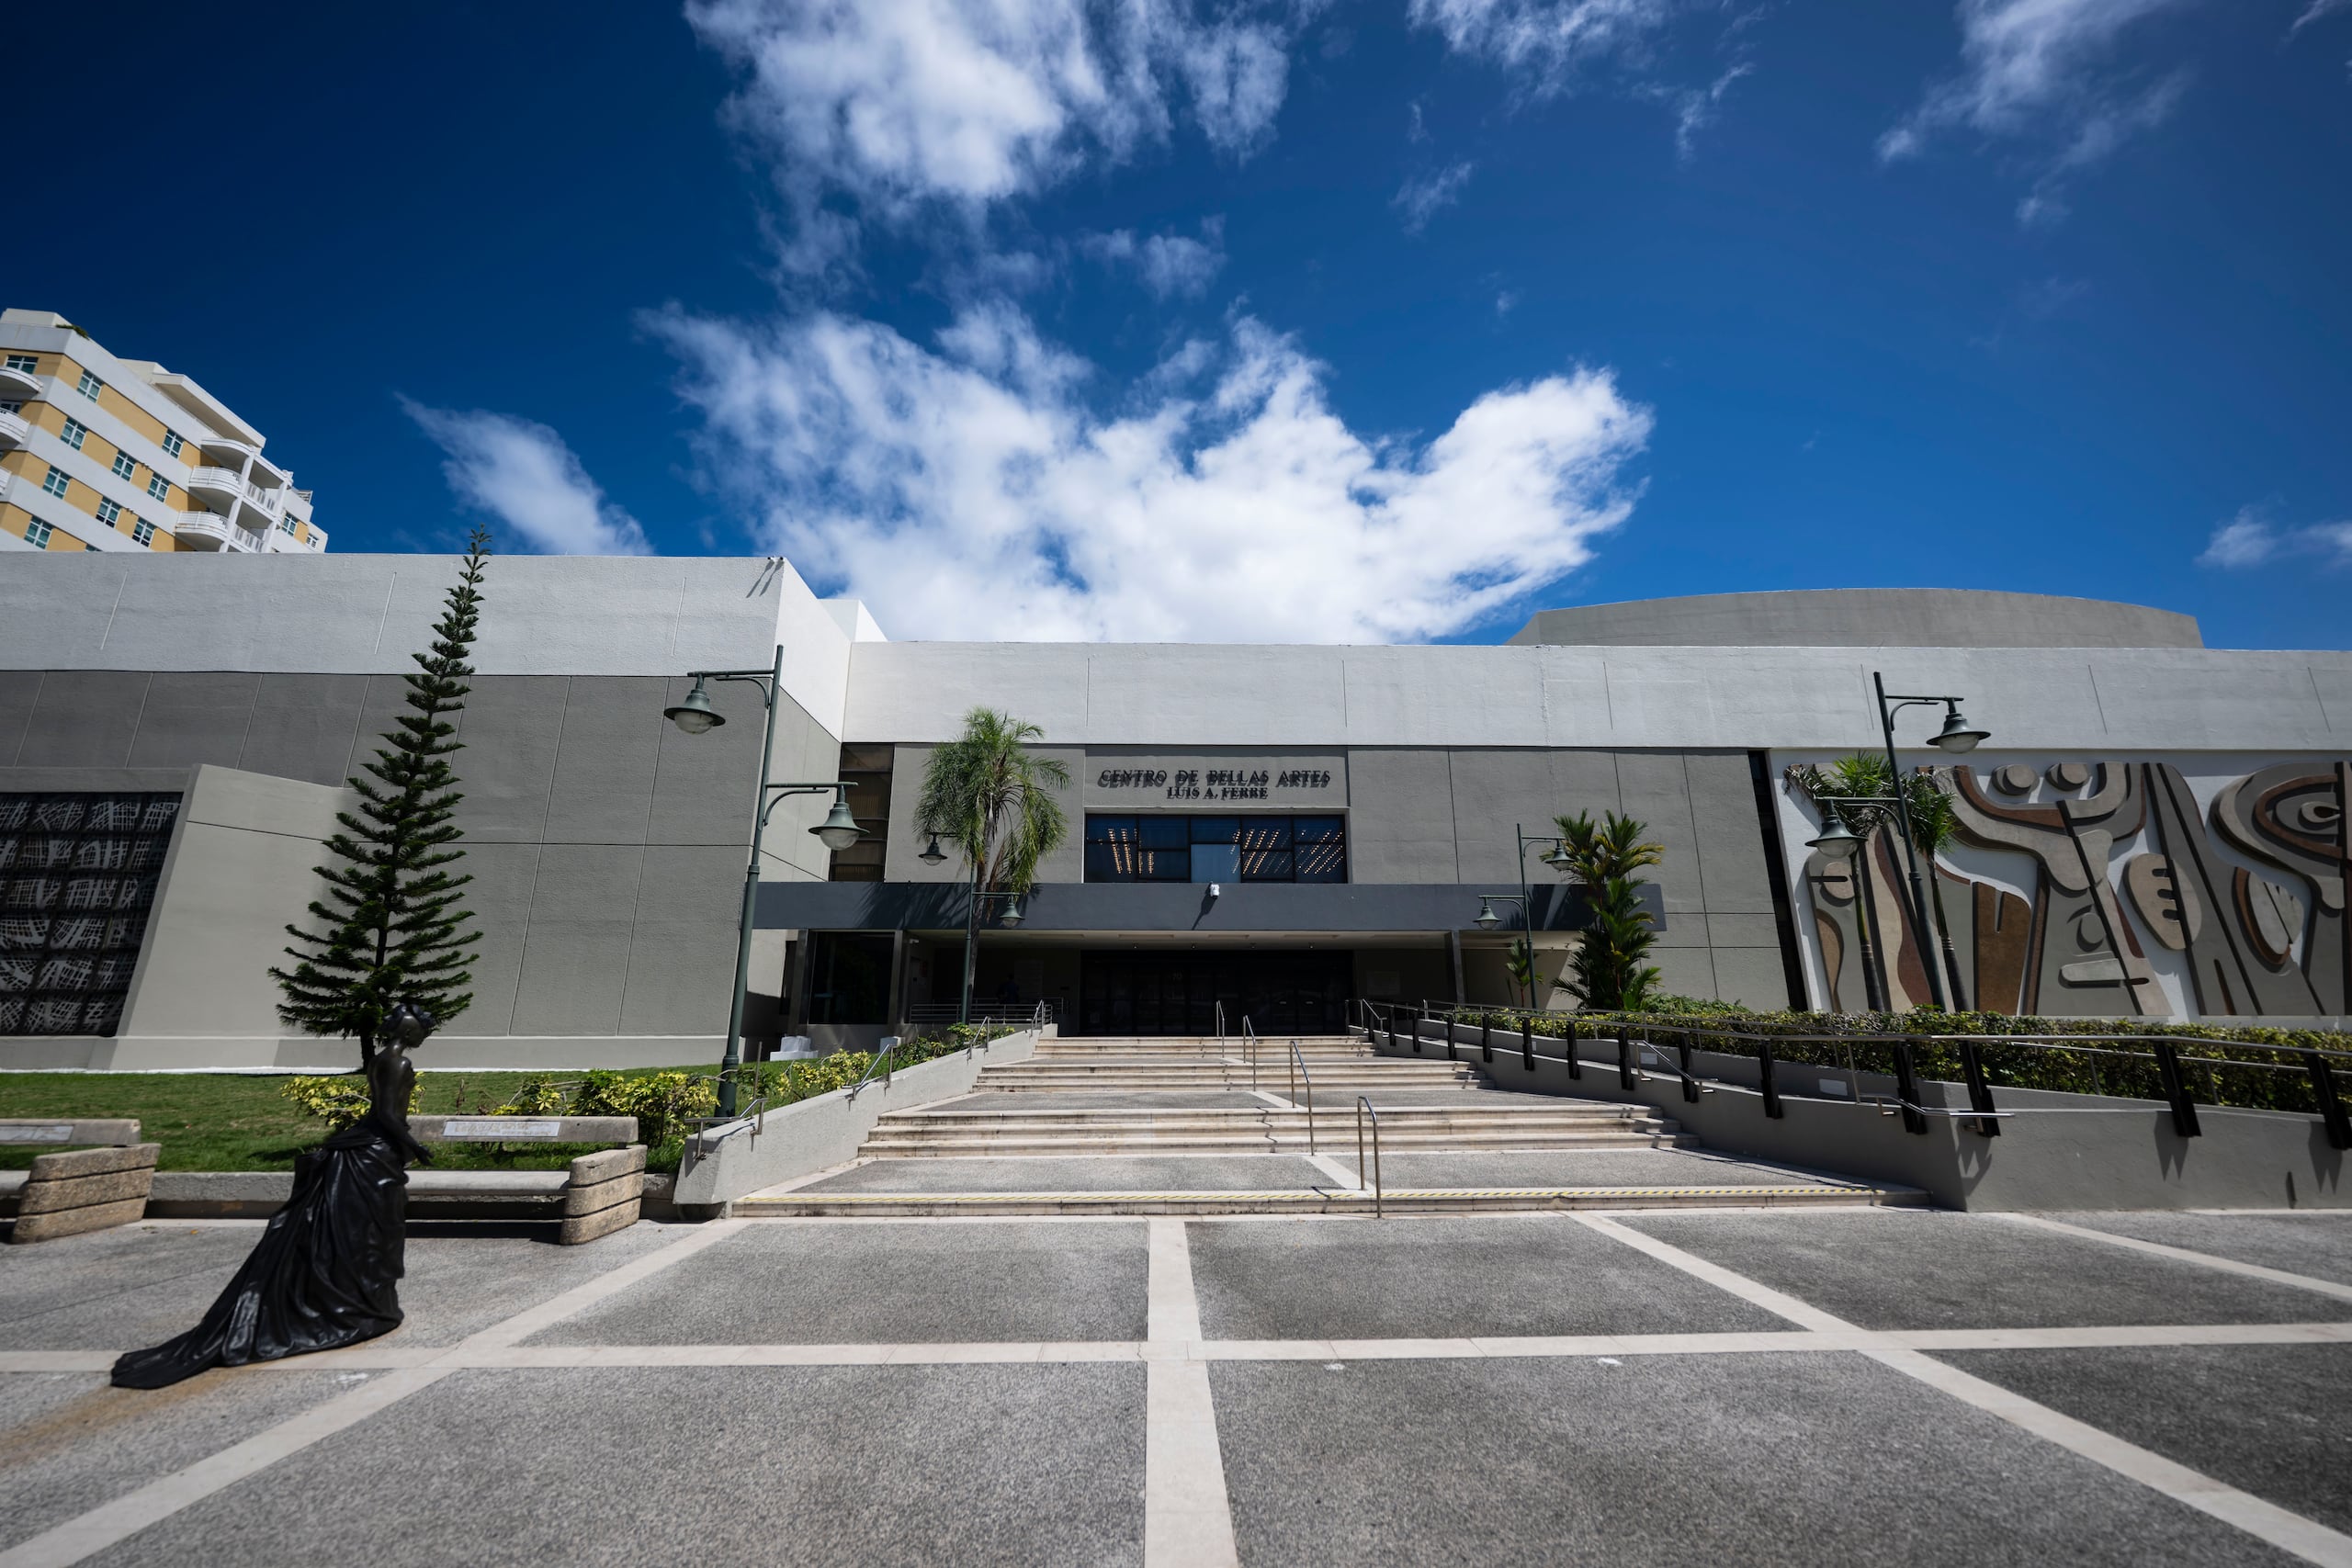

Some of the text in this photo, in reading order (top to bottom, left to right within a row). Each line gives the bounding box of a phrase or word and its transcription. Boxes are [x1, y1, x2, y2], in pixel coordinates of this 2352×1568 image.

[1100, 769, 1331, 784] CENTRO DE BELLAS ARTES
[1167, 786, 1200, 798] LUIS
